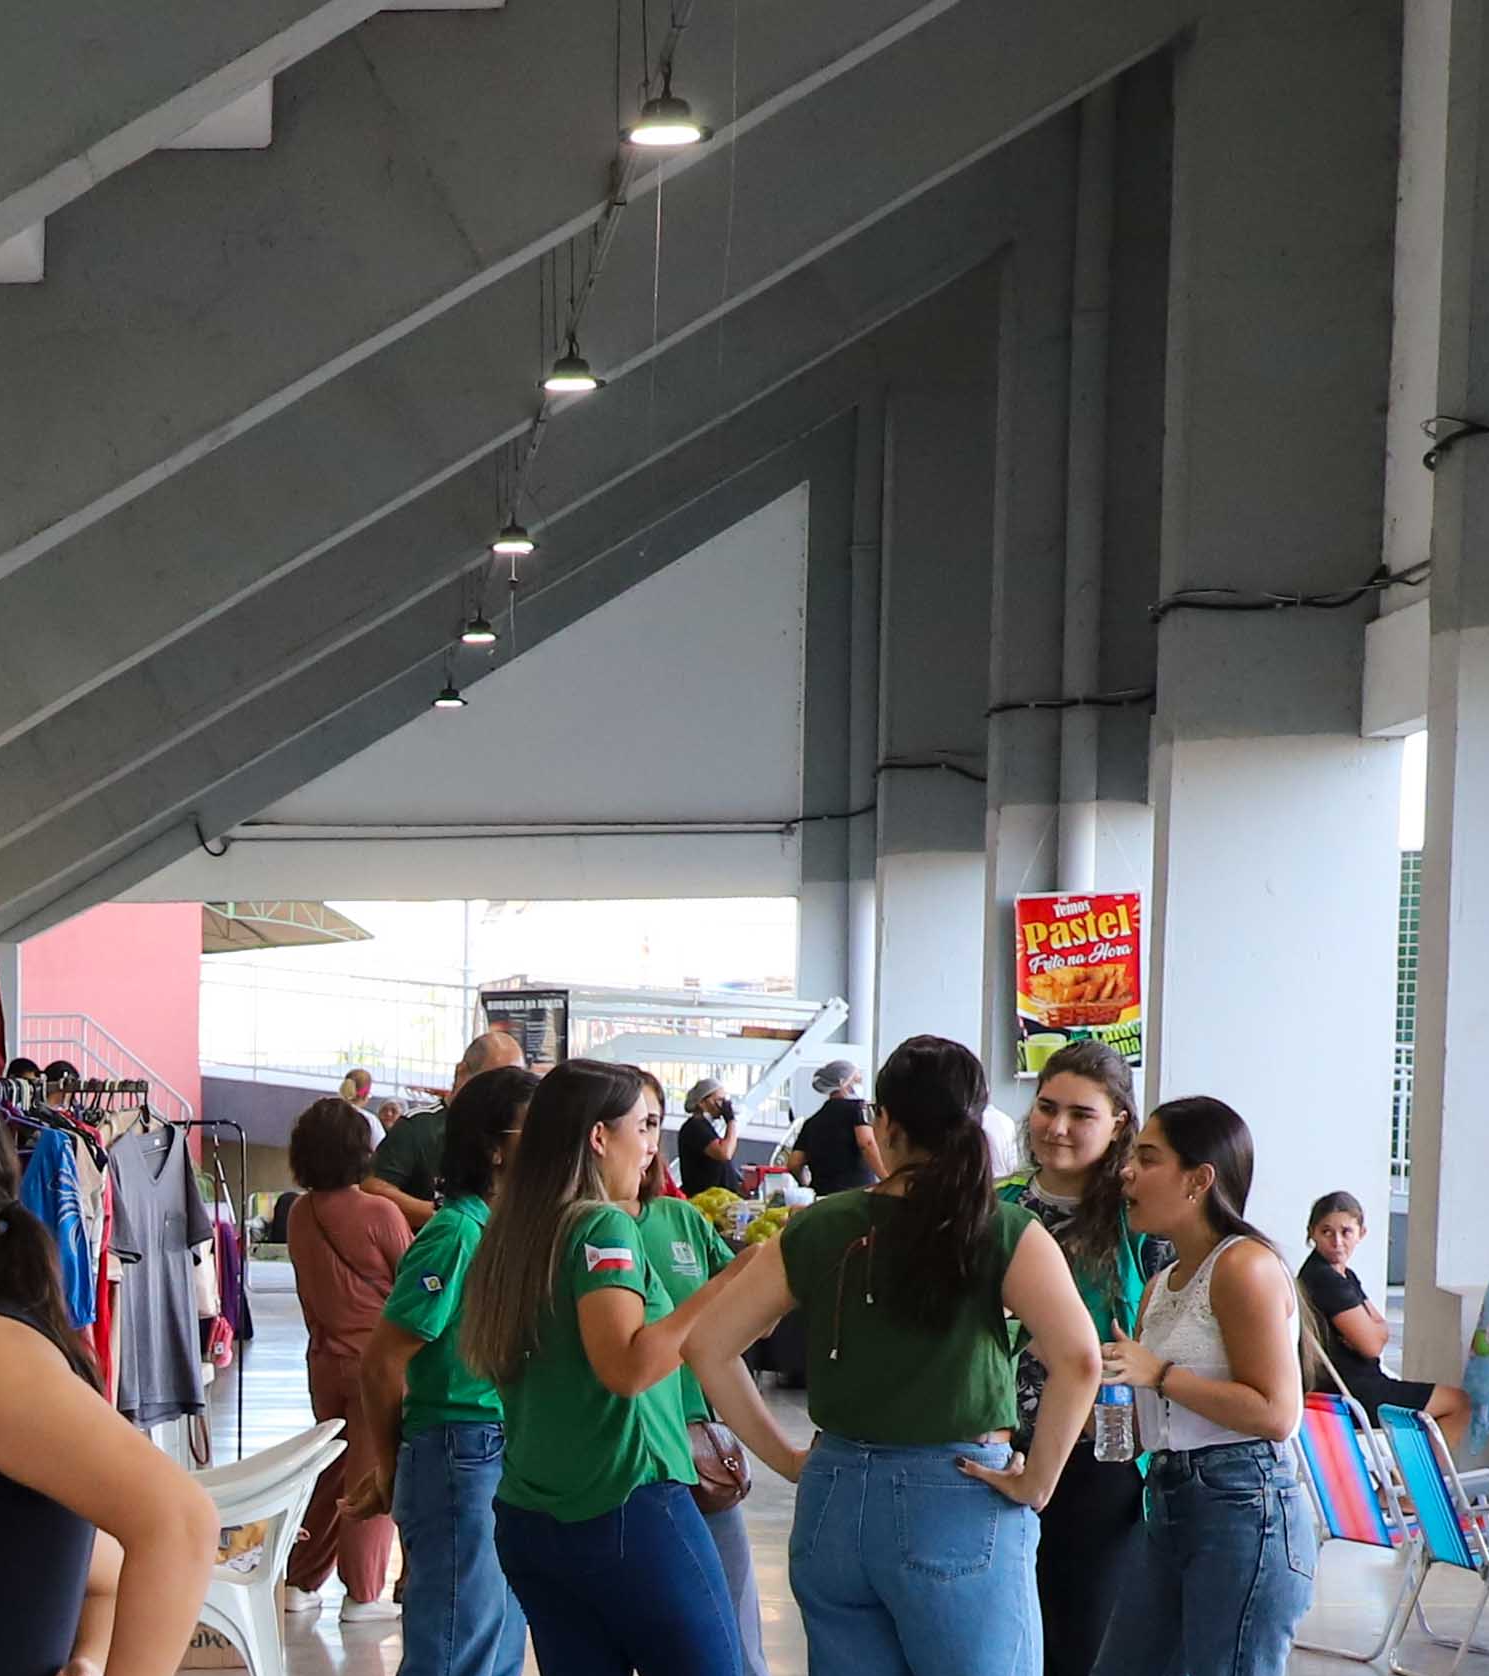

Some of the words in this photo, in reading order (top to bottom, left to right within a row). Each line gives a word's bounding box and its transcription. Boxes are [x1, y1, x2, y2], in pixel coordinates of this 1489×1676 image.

[1053, 899, 1091, 918] Temos
[1022, 904, 1132, 955] Pastel
[1028, 952, 1066, 974] Frito
[1088, 942, 1133, 963] Hora
